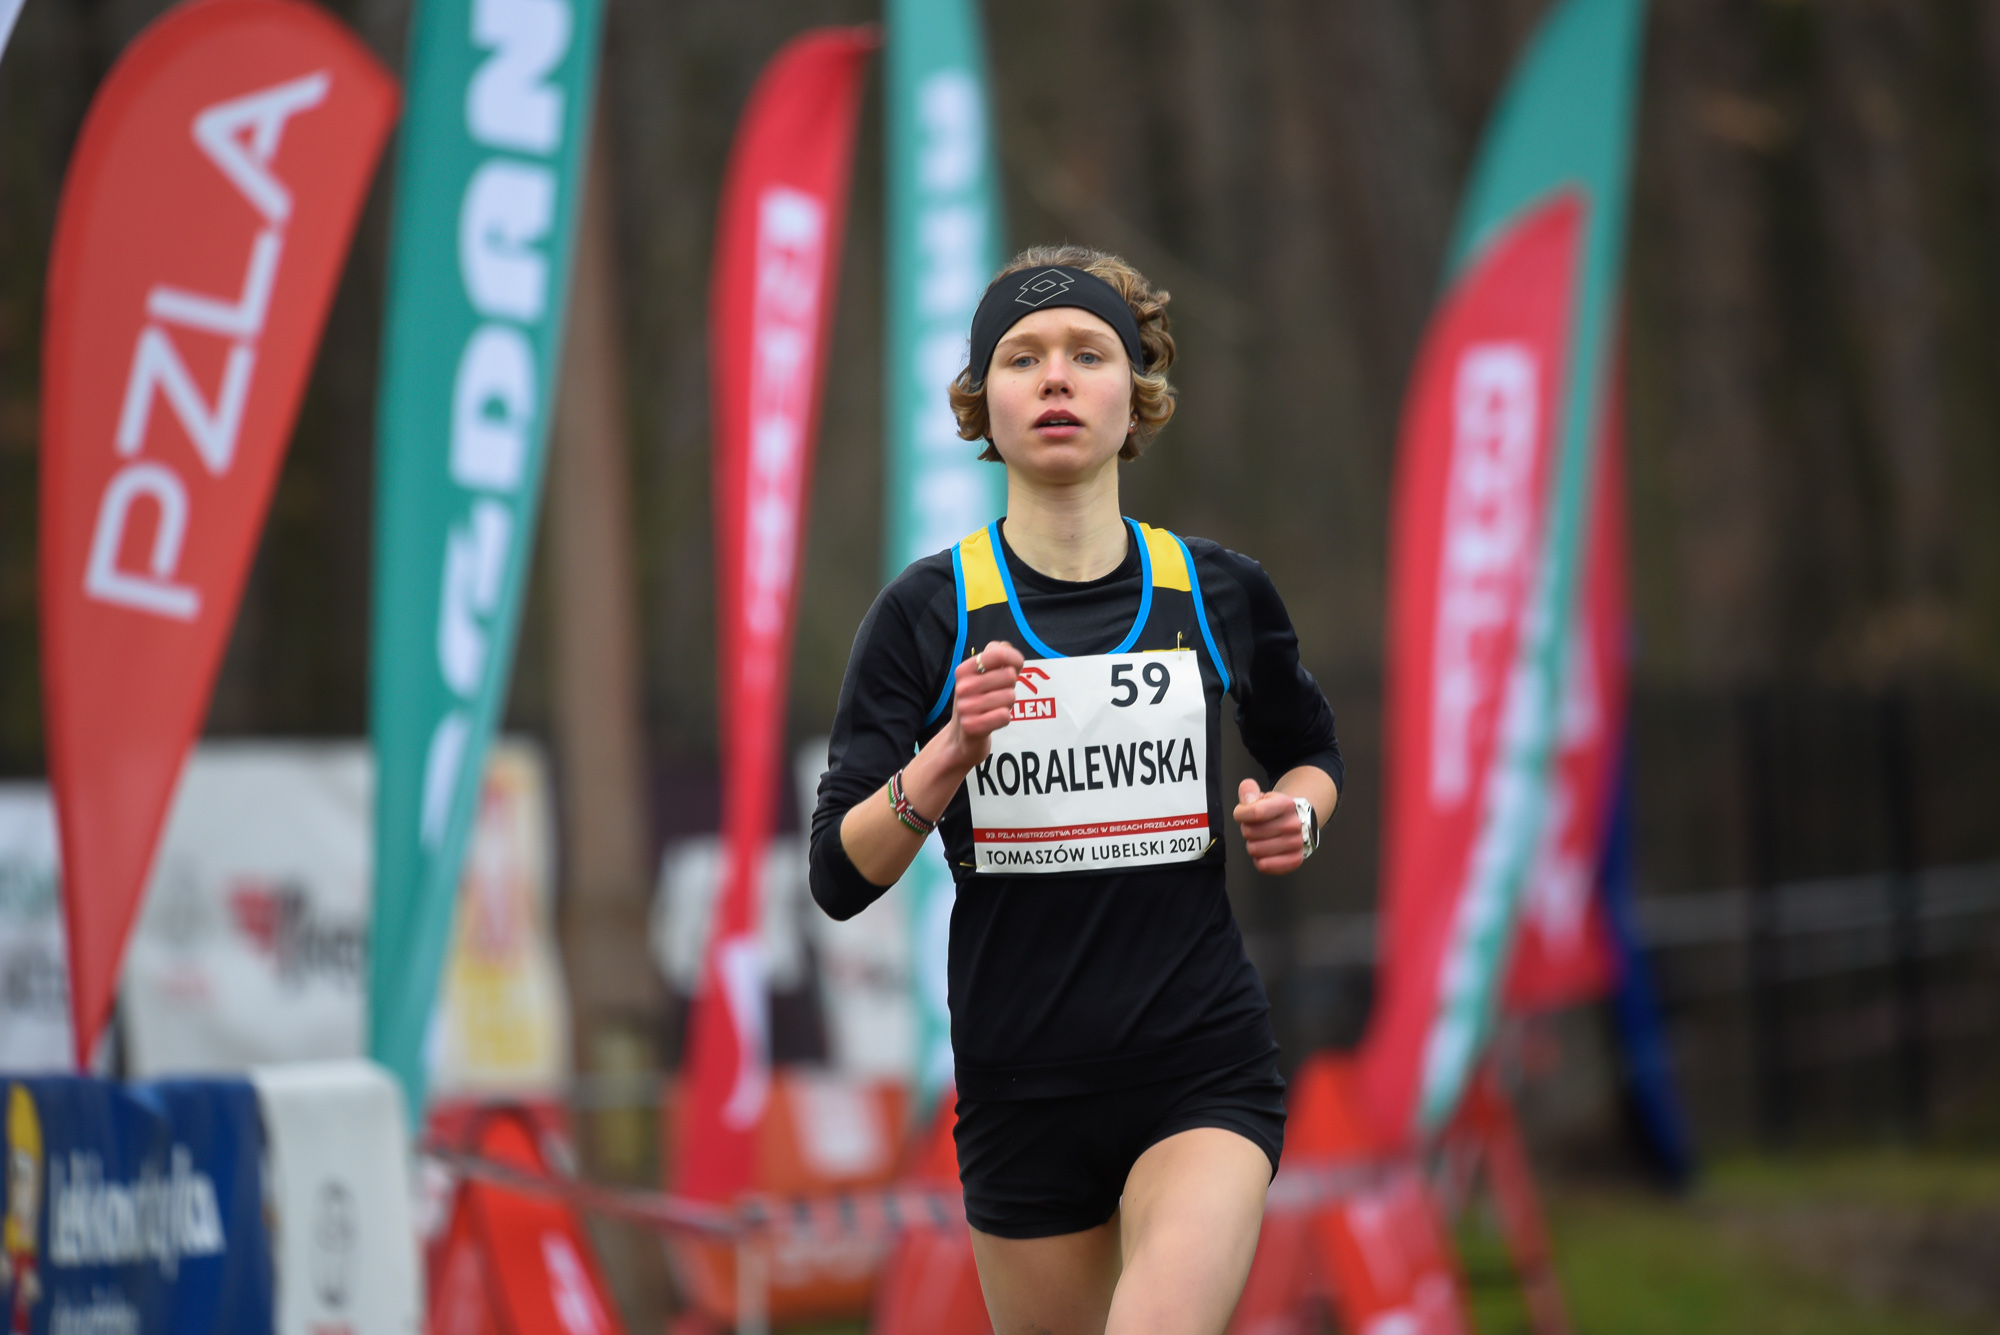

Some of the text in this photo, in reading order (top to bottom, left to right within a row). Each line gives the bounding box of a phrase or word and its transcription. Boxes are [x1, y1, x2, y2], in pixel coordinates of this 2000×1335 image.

[84, 68, 331, 622] PZLA
[1110, 662, 1171, 708] 59
[1010, 700, 1052, 719] LEN
[975, 737, 1198, 796] KORALEWSKA
[998, 831, 1016, 839] PZLA
[1016, 829, 1071, 839] MISTRZOSTWA
[1071, 827, 1099, 836] POLSKI
[1109, 823, 1143, 833] BIEGACH
[986, 836, 1202, 865] TOMASZÓW LUBELSKI 2021
